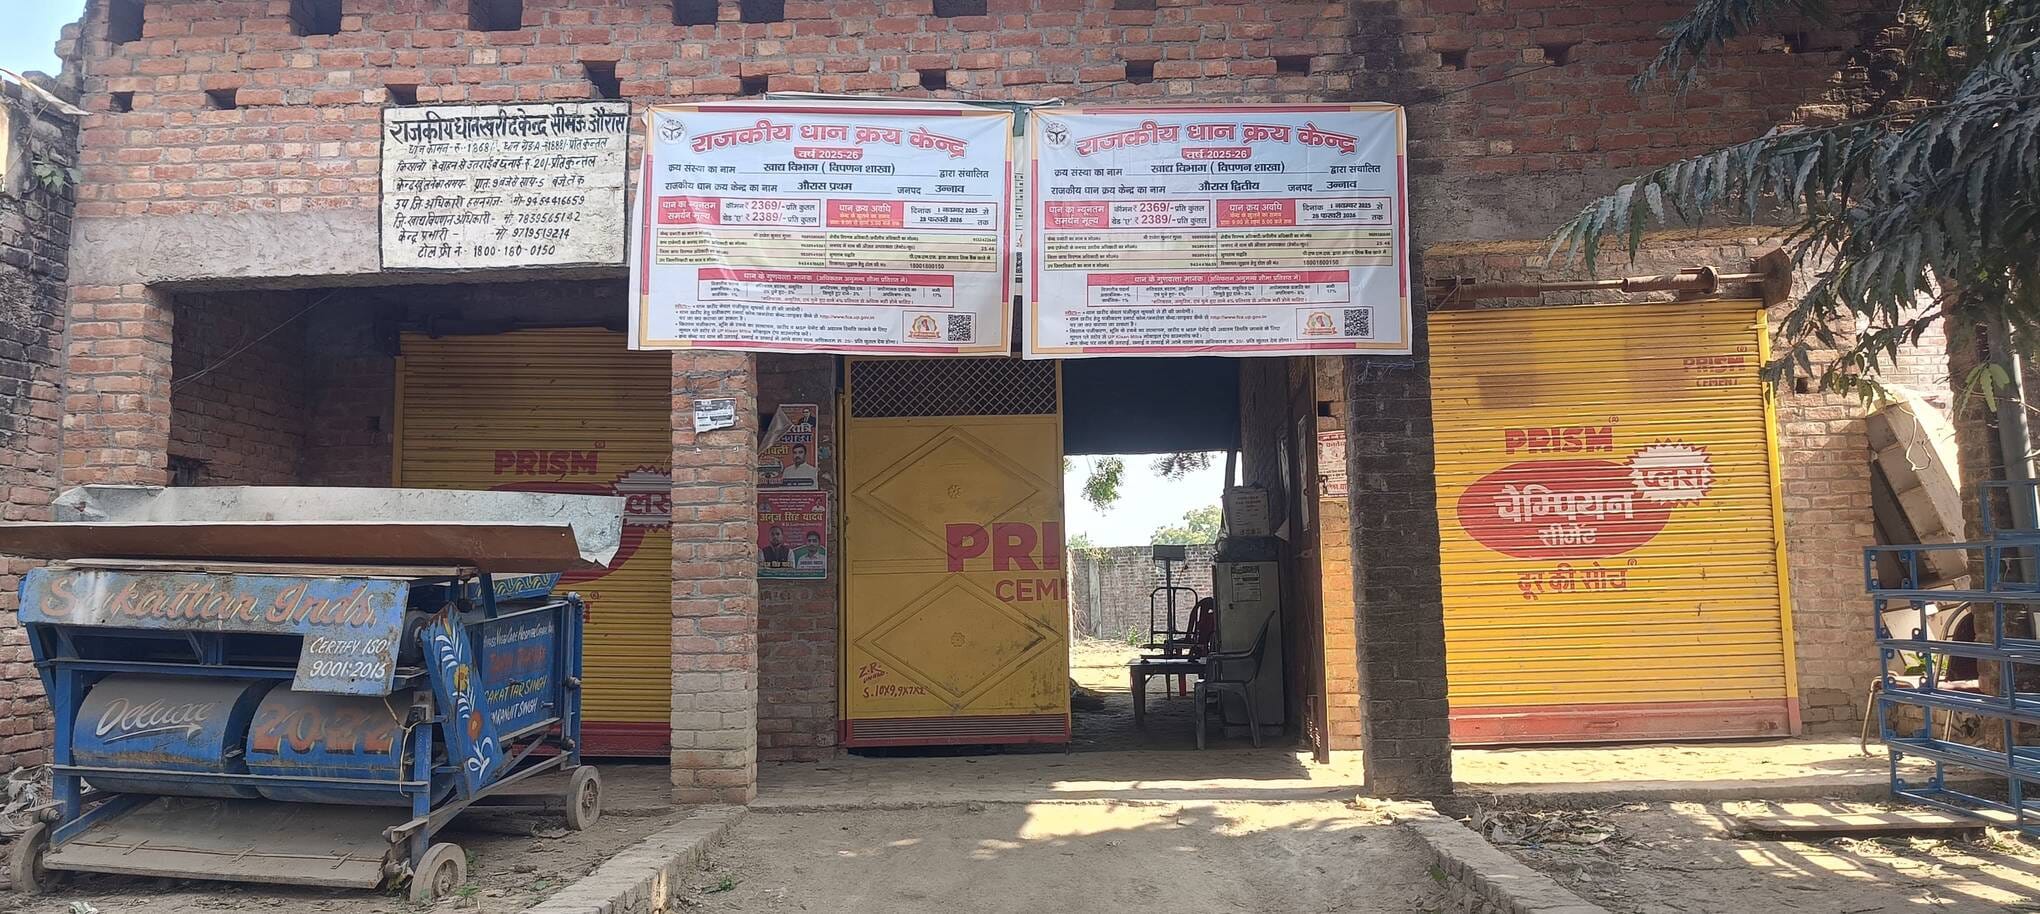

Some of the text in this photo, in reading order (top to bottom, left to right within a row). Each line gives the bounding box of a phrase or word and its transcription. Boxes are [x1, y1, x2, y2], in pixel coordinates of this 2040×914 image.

[390, 111, 454, 143] राजकीय
[691, 119, 793, 153] राजकीय
[800, 124, 848, 141] धान
[855, 125, 902, 146] क्रय
[908, 127, 968, 158] केन्द्र
[1076, 120, 1360, 155] राजकीय धान क्रय केन्द्र
[798, 149, 860, 160] वर्ष 2025-26
[1186, 149, 1248, 159] वर्ष 2025-26
[708, 165, 717, 173] का
[720, 165, 736, 174] नाम
[764, 163, 785, 173] खाद्य
[788, 161, 818, 173] विभाग
[829, 162, 862, 174] विपणन
[939, 168, 956, 179] द्वारा
[958, 167, 989, 178] संचालित
[1054, 168, 1068, 177] क्रय
[1071, 166, 1092, 177] संस्था
[1094, 168, 1104, 176] का
[1106, 168, 1123, 176] नाम
[1151, 164, 1173, 173] खाद्य
[1176, 162, 1207, 173] विभाग
[1218, 161, 1251, 173] विपणन
[1330, 164, 1347, 175] द्वारा
[1349, 162, 1381, 173] संचालित
[665, 179, 694, 191] राजकीय
[697, 182, 711, 191] धान
[731, 181, 747, 193] केन्द्र
[749, 184, 759, 192] का
[762, 184, 778, 193] नाम
[797, 179, 826, 191] औरास
[829, 182, 853, 192] प्रथम
[897, 186, 921, 195] जनपद
[935, 184, 965, 194] उन्नाव
[1051, 179, 1357, 195] राजकीय धान क्रय केन्द्र का नाम औरास द्वितीय जनपद उन्नाव
[839, 203, 852, 213] धान
[871, 202, 891, 213] अवधि
[1140, 202, 1174, 213] 2369/-
[1230, 203, 1243, 212] धान
[1262, 201, 1283, 211] अवधि
[1142, 213, 1177, 225] 2389/-
[1504, 427, 1614, 455] PRISM
[494, 450, 599, 476] PRISM
[1493, 484, 1635, 523] चैम्पियन
[945, 521, 1061, 573] PRI
[1549, 562, 1576, 591] की
[310, 636, 361, 655] CERTIFY
